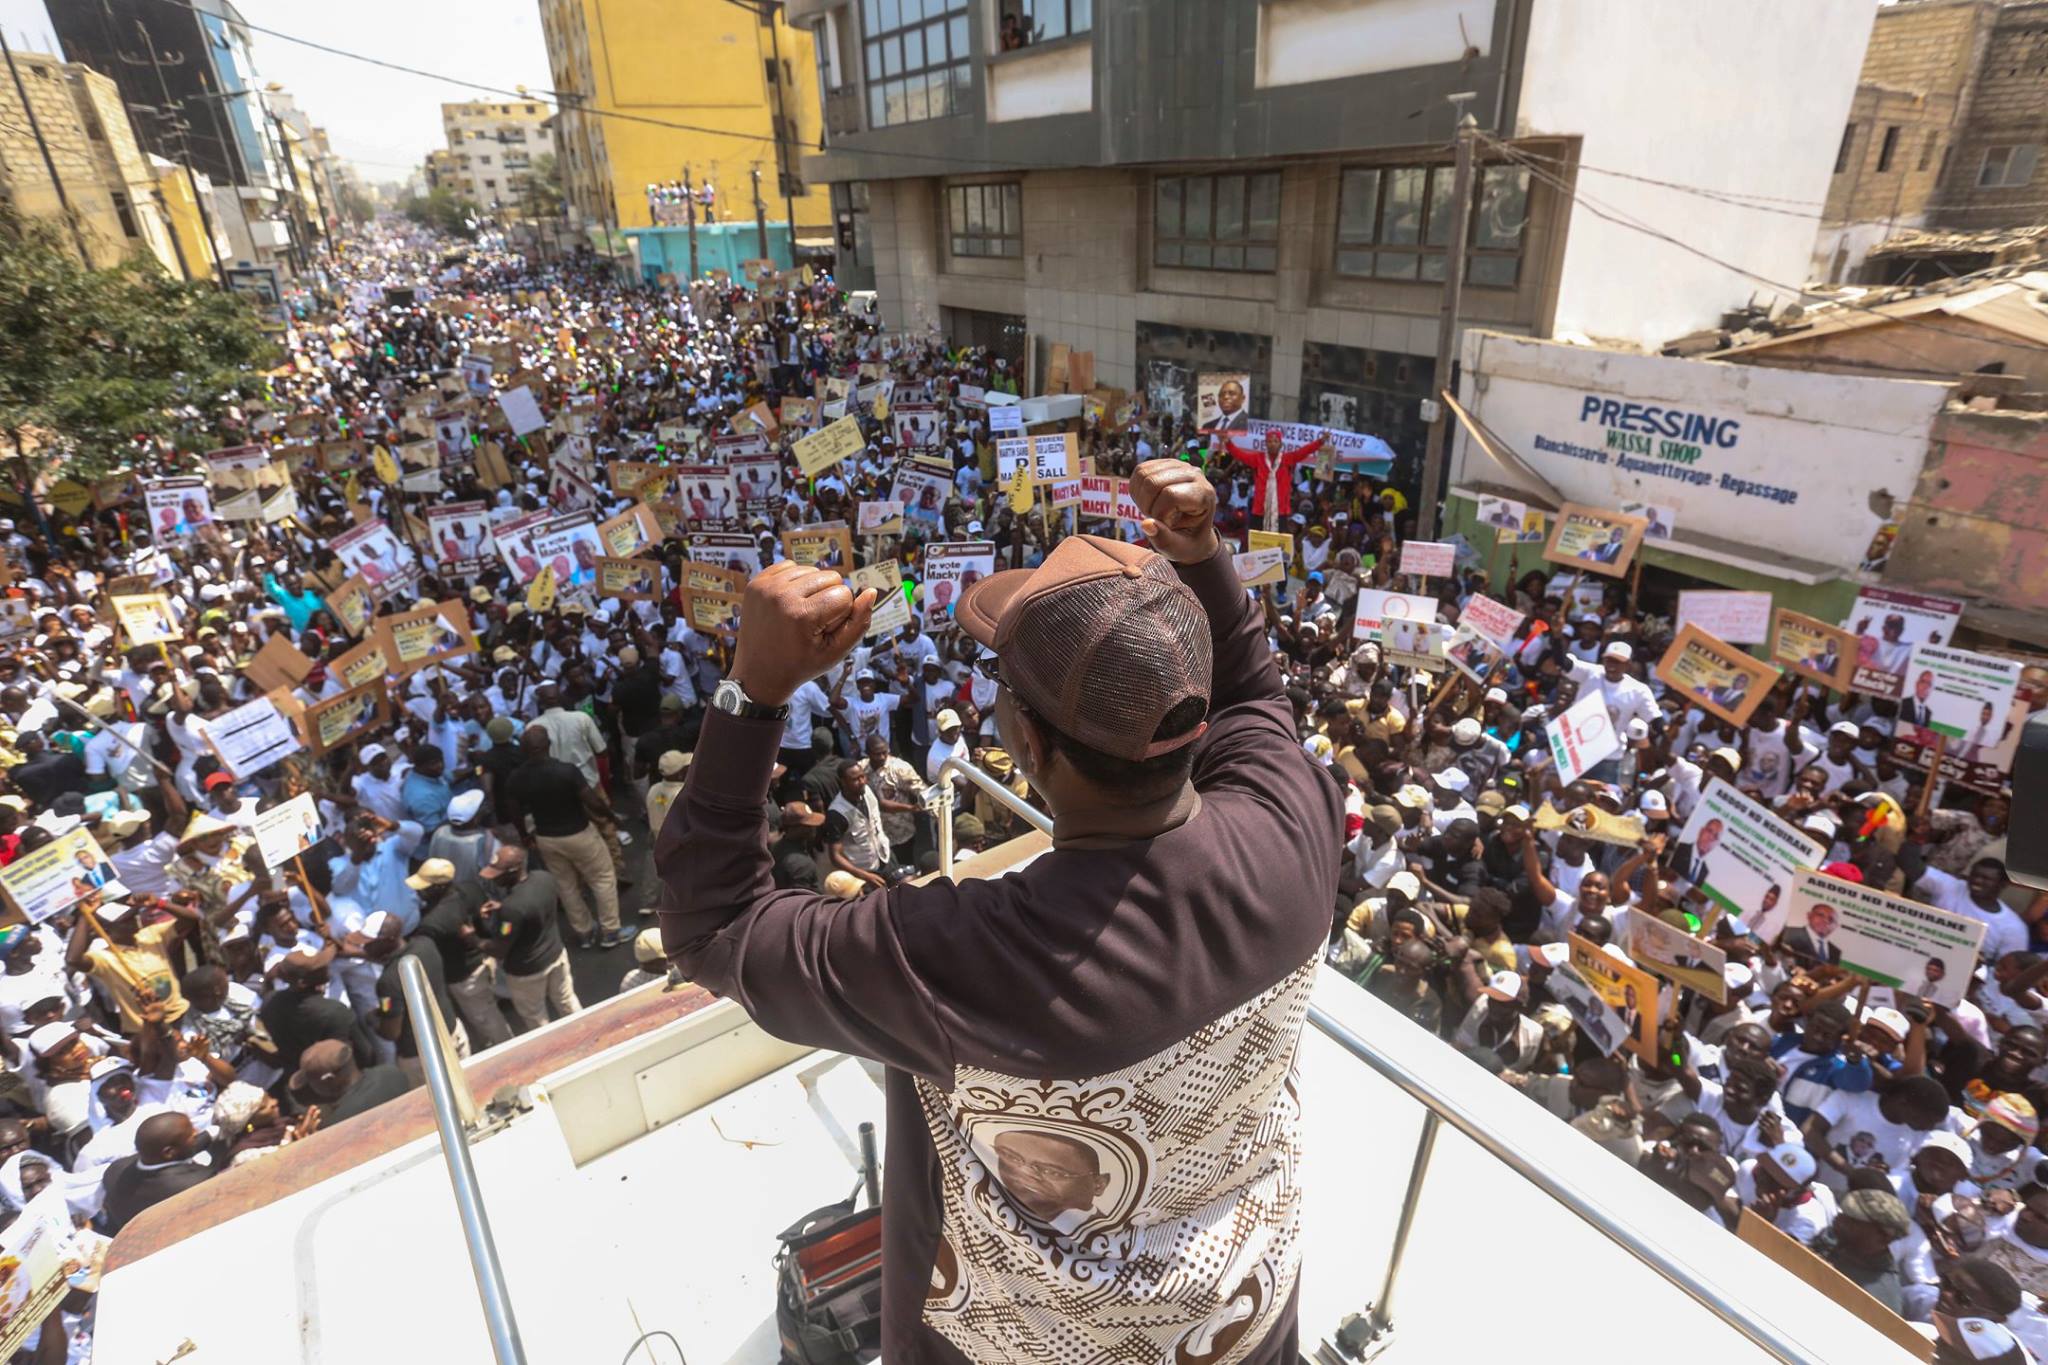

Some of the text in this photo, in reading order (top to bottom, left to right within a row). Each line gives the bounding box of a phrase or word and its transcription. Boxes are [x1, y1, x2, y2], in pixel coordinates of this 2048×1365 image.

[1580, 395, 1740, 449] PRESSING
[1298, 428, 1315, 441] DES
[1606, 429, 1702, 465] WASSA SHOP
[1037, 467, 1066, 479] SALL
[1534, 434, 1798, 505] Blanchisserie Aquanettoyage Repassage
[897, 478, 922, 490] Macky
[1082, 477, 1111, 492] MARTIN
[1082, 499, 1144, 520] MACKY SALL
[538, 545, 570, 558] Macky
[927, 561, 960, 570] je vote
[927, 571, 960, 581] Macky
[1853, 676, 1896, 695] Macky
[1716, 789, 1813, 857] ABDOU ND NGUIRANE
[1807, 876, 1967, 933] ABDOU ND NGUIRANE
